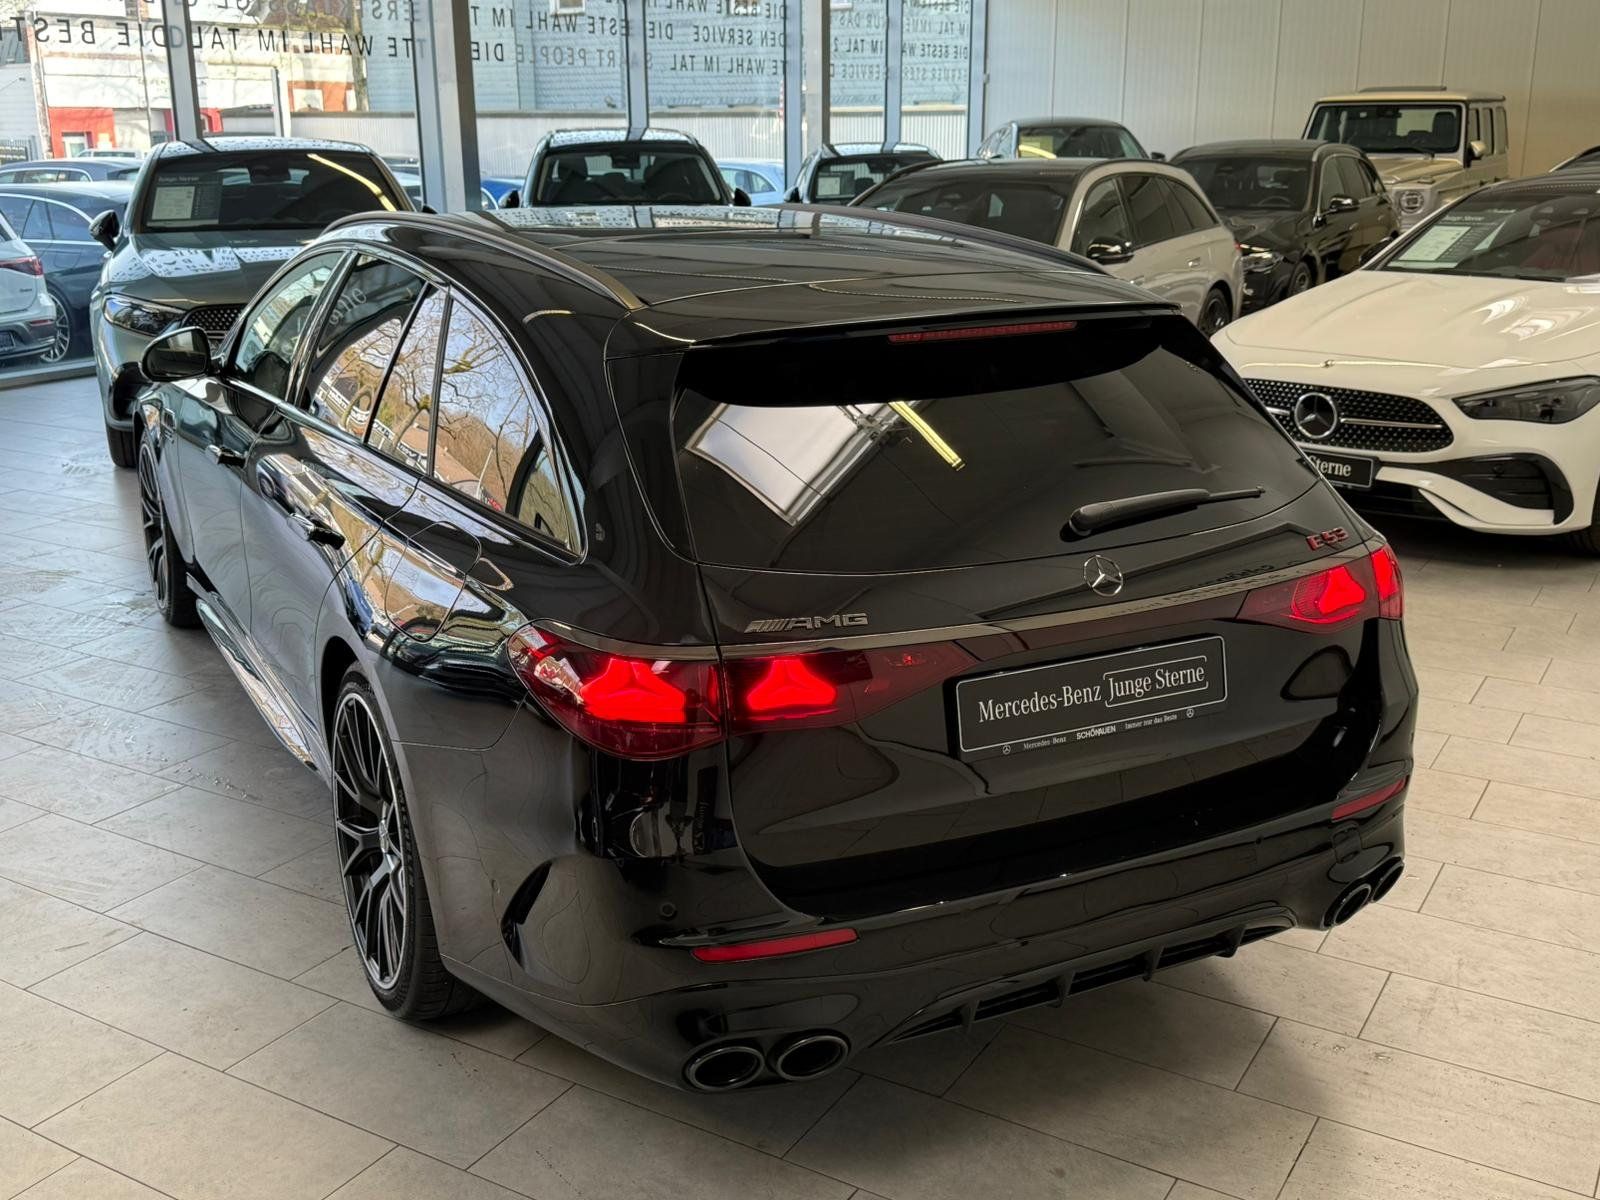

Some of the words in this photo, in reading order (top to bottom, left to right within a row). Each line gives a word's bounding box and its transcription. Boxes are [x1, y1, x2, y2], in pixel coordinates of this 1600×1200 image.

[782, 612, 869, 632] AMG
[978, 684, 1102, 723] Mercedes-Benz
[1108, 676, 1152, 702] Junge
[1155, 667, 1205, 690] Sterne
[1076, 725, 1117, 741] SCHÖNAUEN
